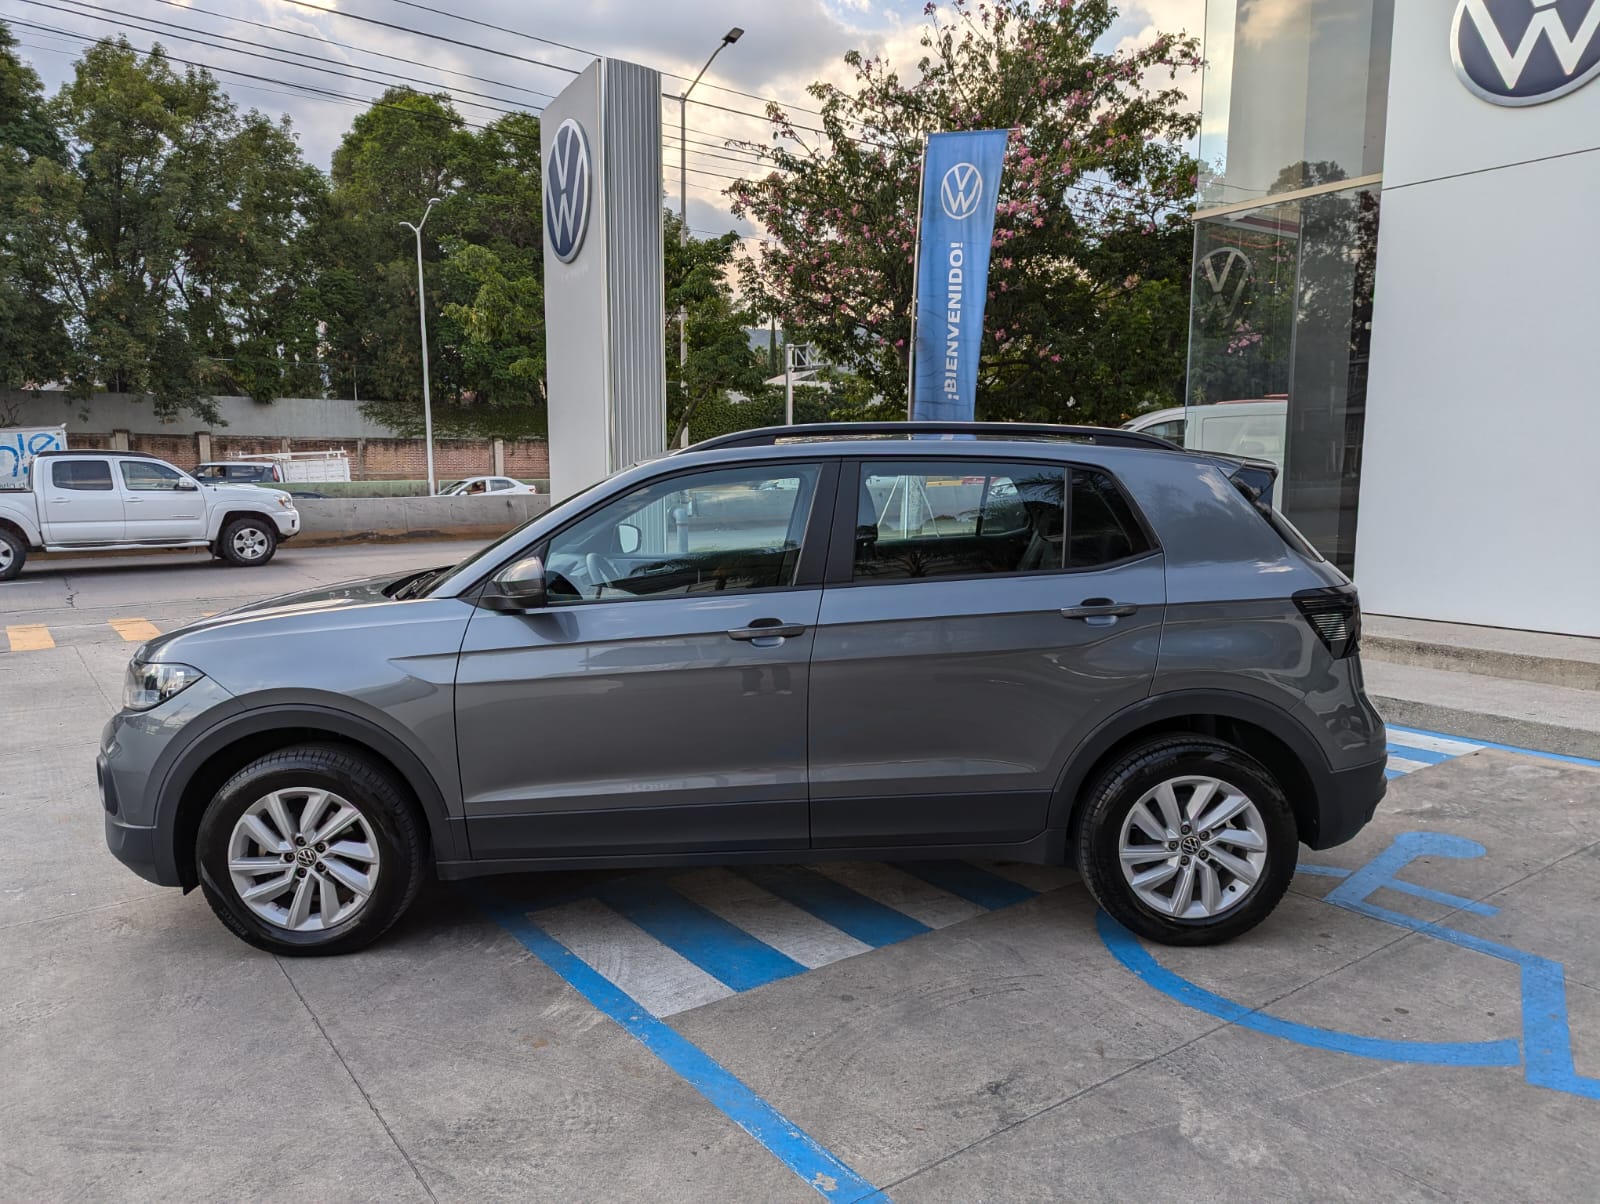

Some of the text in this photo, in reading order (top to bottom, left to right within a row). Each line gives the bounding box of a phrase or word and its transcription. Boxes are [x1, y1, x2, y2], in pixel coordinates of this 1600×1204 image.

[548, 122, 587, 251] VW
[943, 166, 981, 214] VW
[944, 242, 963, 400] ¡BIENVENIDO!
